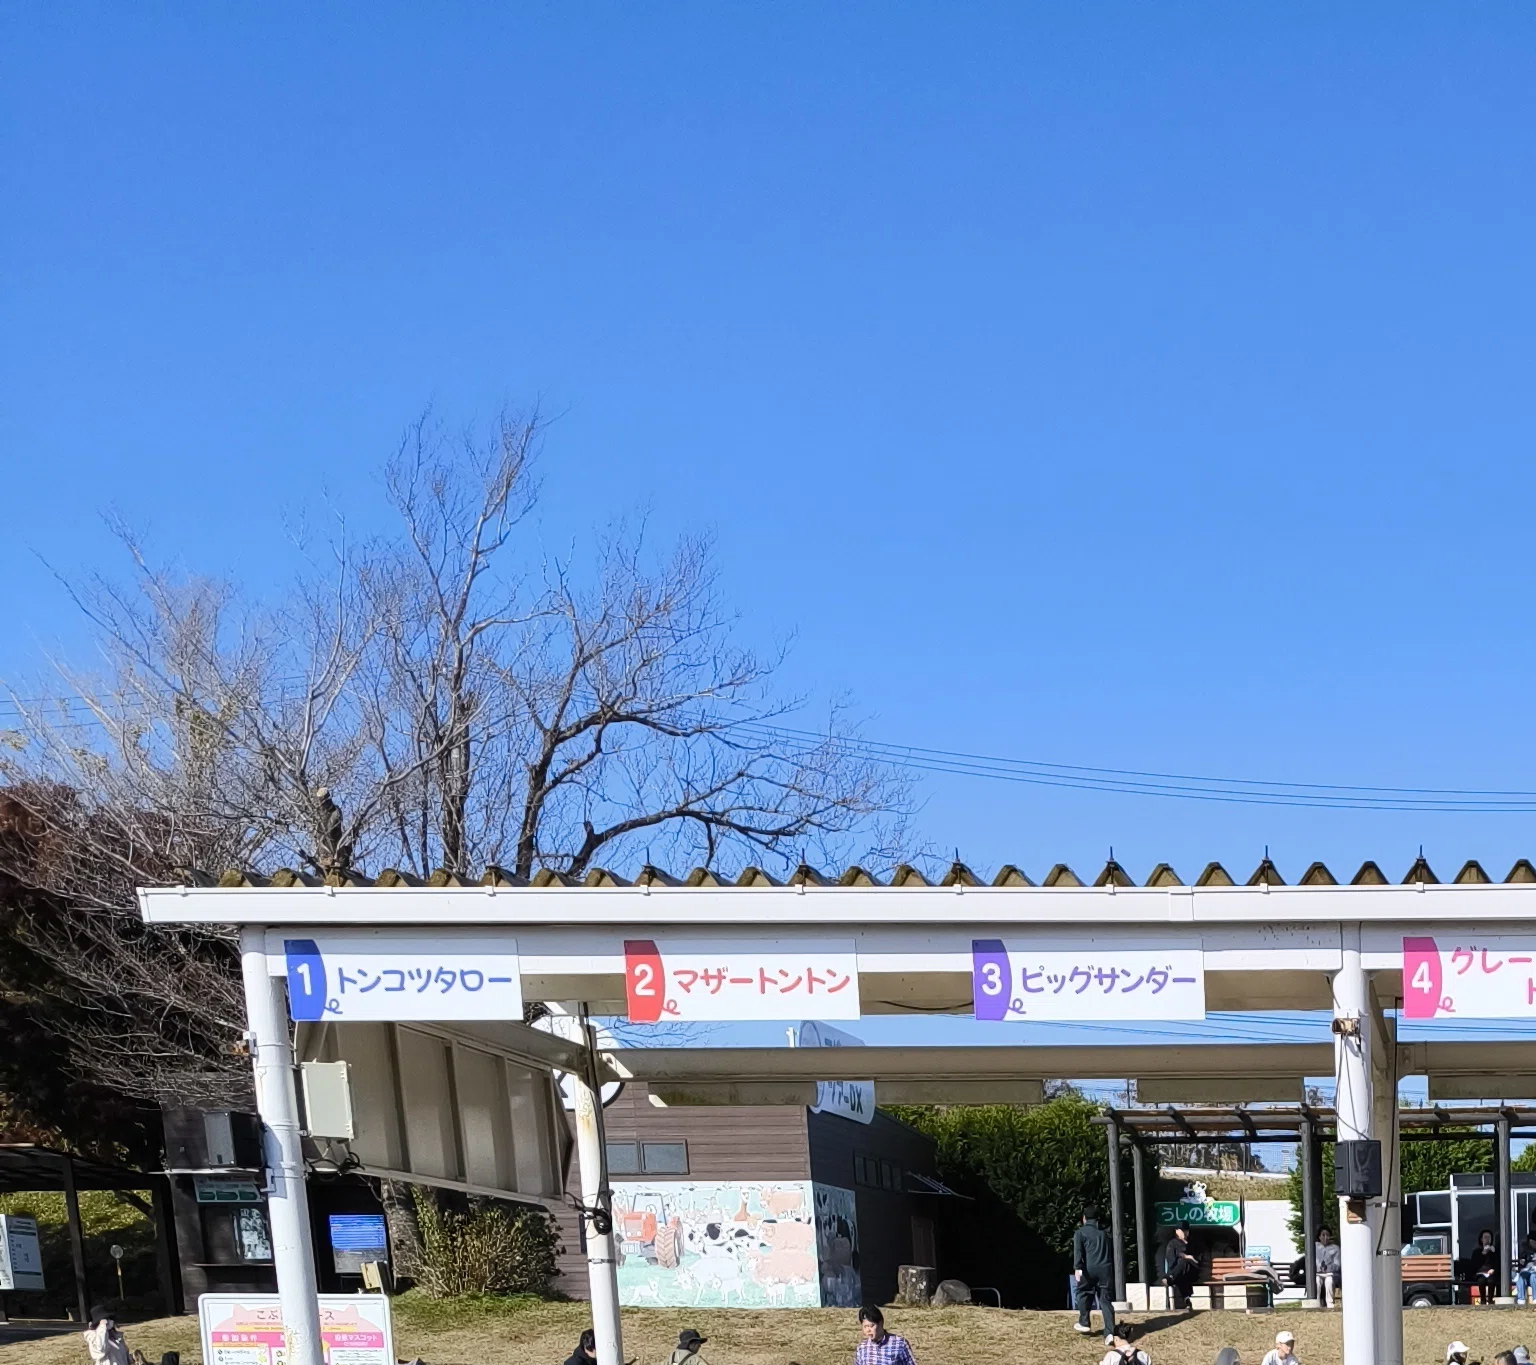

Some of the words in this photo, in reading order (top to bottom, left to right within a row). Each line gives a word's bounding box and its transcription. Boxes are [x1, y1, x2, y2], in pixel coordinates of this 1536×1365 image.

[297, 962, 312, 996] 1
[338, 966, 512, 994] トンコツタロー
[634, 963, 655, 996] 2
[673, 966, 851, 995] マザートントン
[981, 962, 1003, 996] 3
[1021, 964, 1197, 995] ピッグサンダー
[1411, 961, 1433, 995] 4
